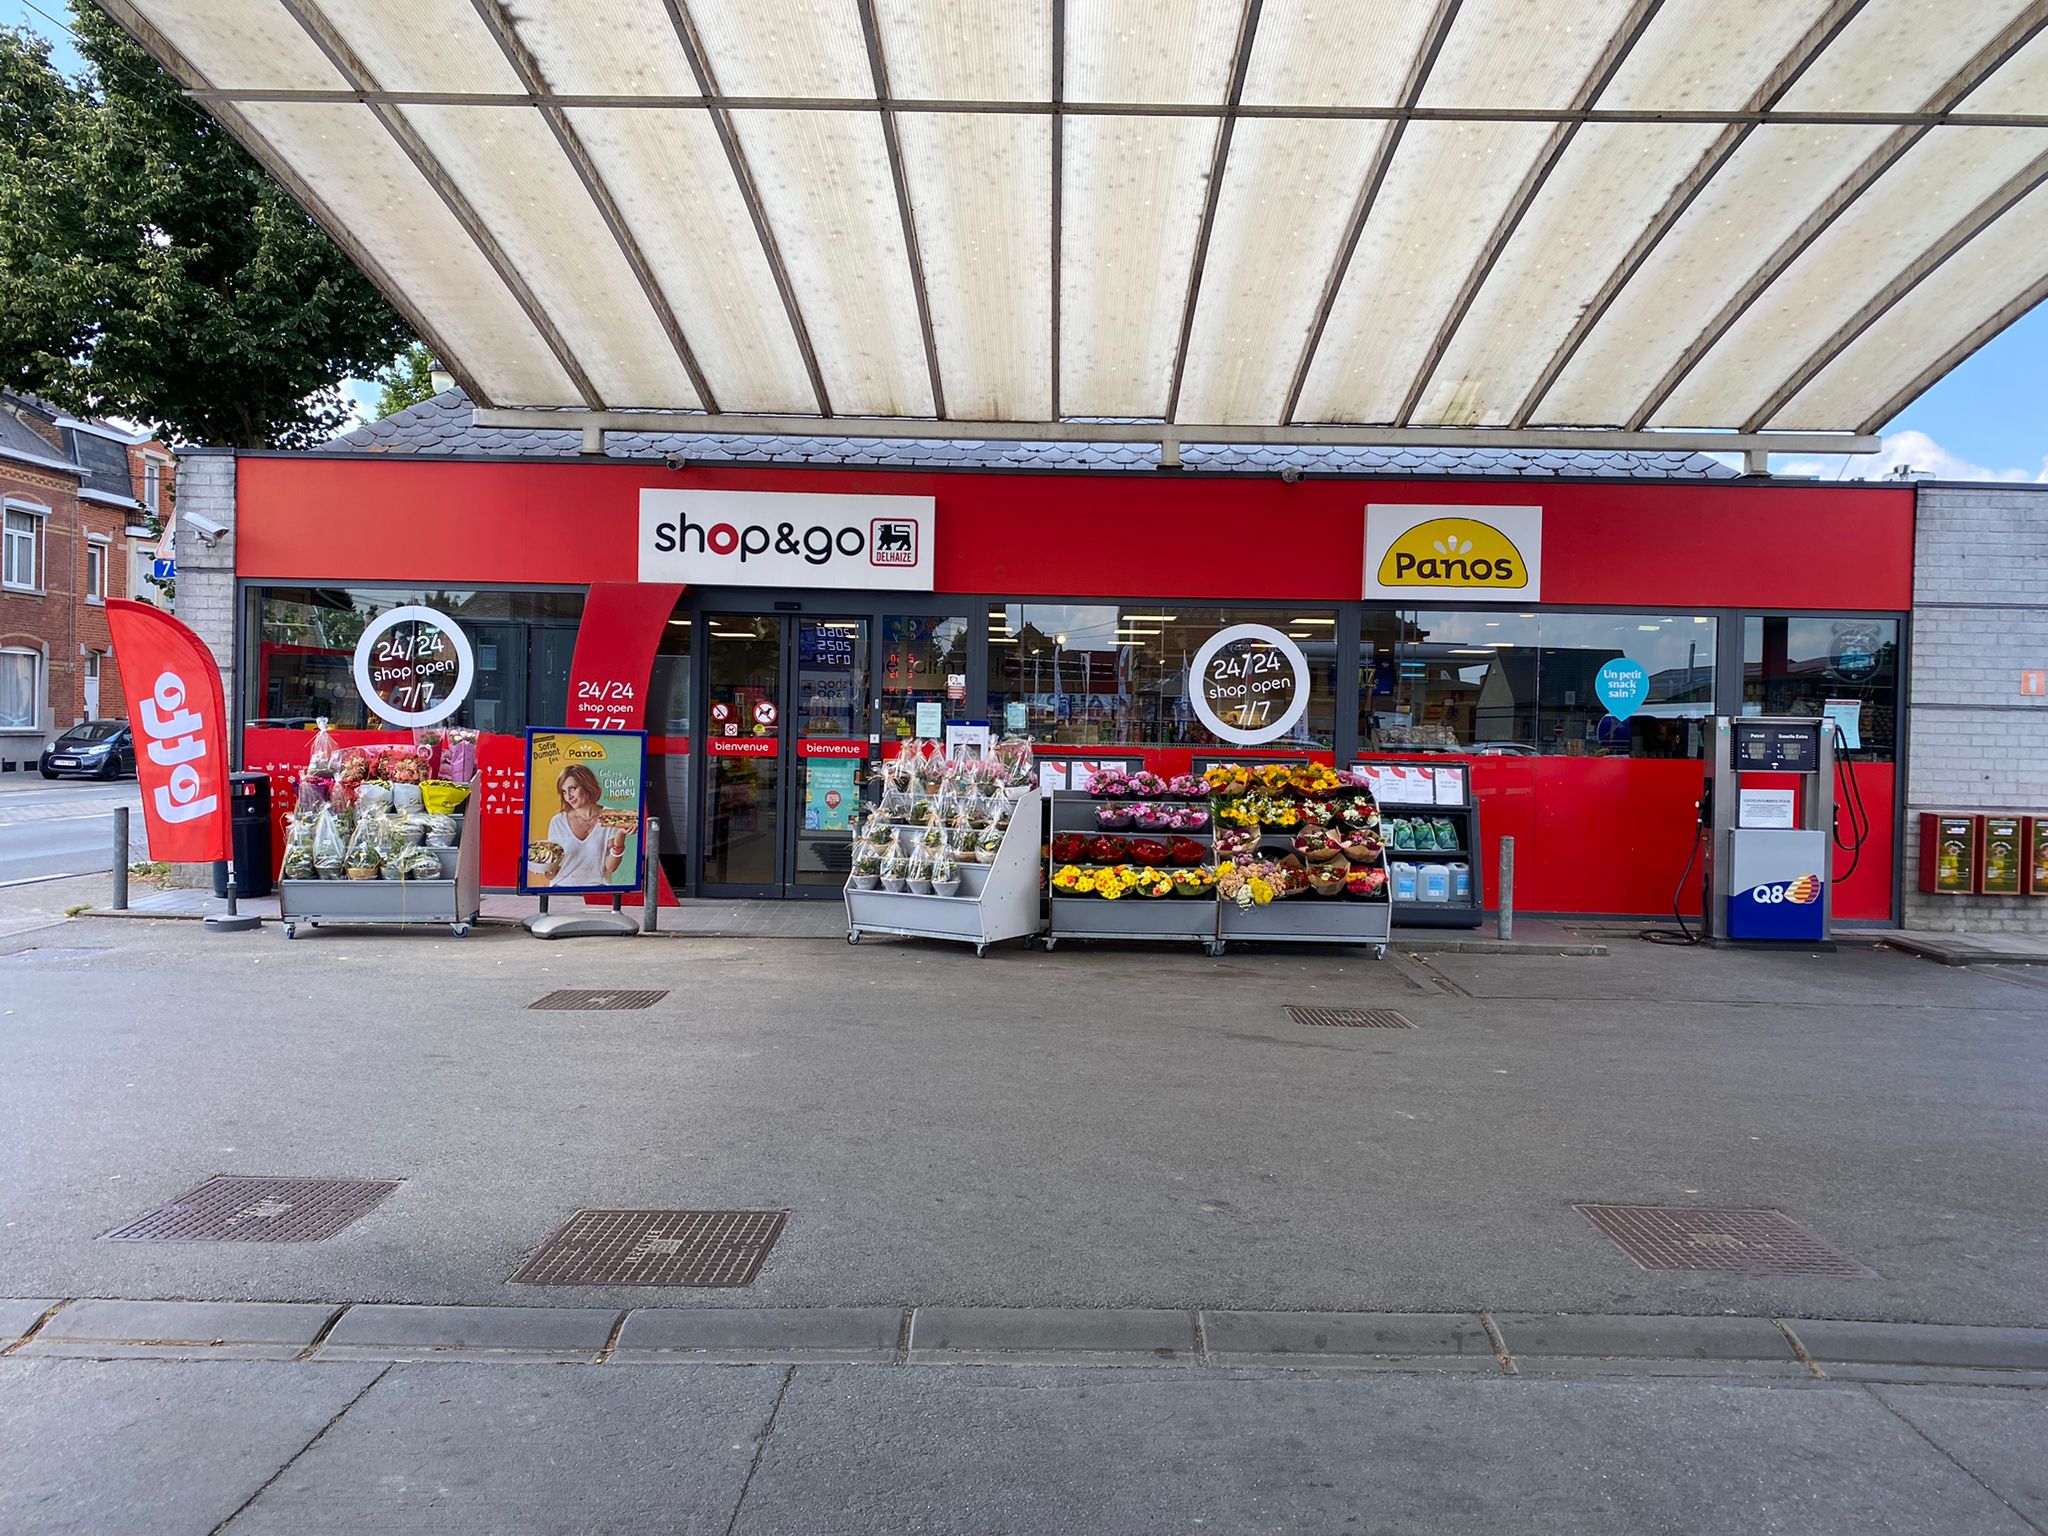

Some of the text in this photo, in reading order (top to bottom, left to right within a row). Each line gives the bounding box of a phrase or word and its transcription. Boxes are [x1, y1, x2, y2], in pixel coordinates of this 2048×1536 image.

[655, 511, 866, 565] shop&go
[876, 551, 912, 563] DELHAIZE
[1395, 552, 1513, 580] Panos
[377, 633, 444, 662] 24/24
[373, 659, 454, 682] shop open
[1212, 651, 1281, 680] 24/24
[1603, 670, 1642, 681] Un petit
[578, 681, 634, 701] 24/24
[1209, 677, 1290, 699] shop open
[1608, 680, 1637, 689] snack
[398, 682, 435, 709] 7/7
[578, 702, 634, 714] shop open
[1234, 700, 1271, 726] 7/7
[584, 716, 626, 730] 7/7
[538, 742, 557, 751] Sofie
[568, 749, 604, 758] Panos
[714, 741, 769, 752] bienvenue
[806, 743, 860, 754] bienvenue
[533, 748, 561, 760] Dumont
[609, 788, 635, 798] honey
[1753, 885, 1784, 904] Q8
